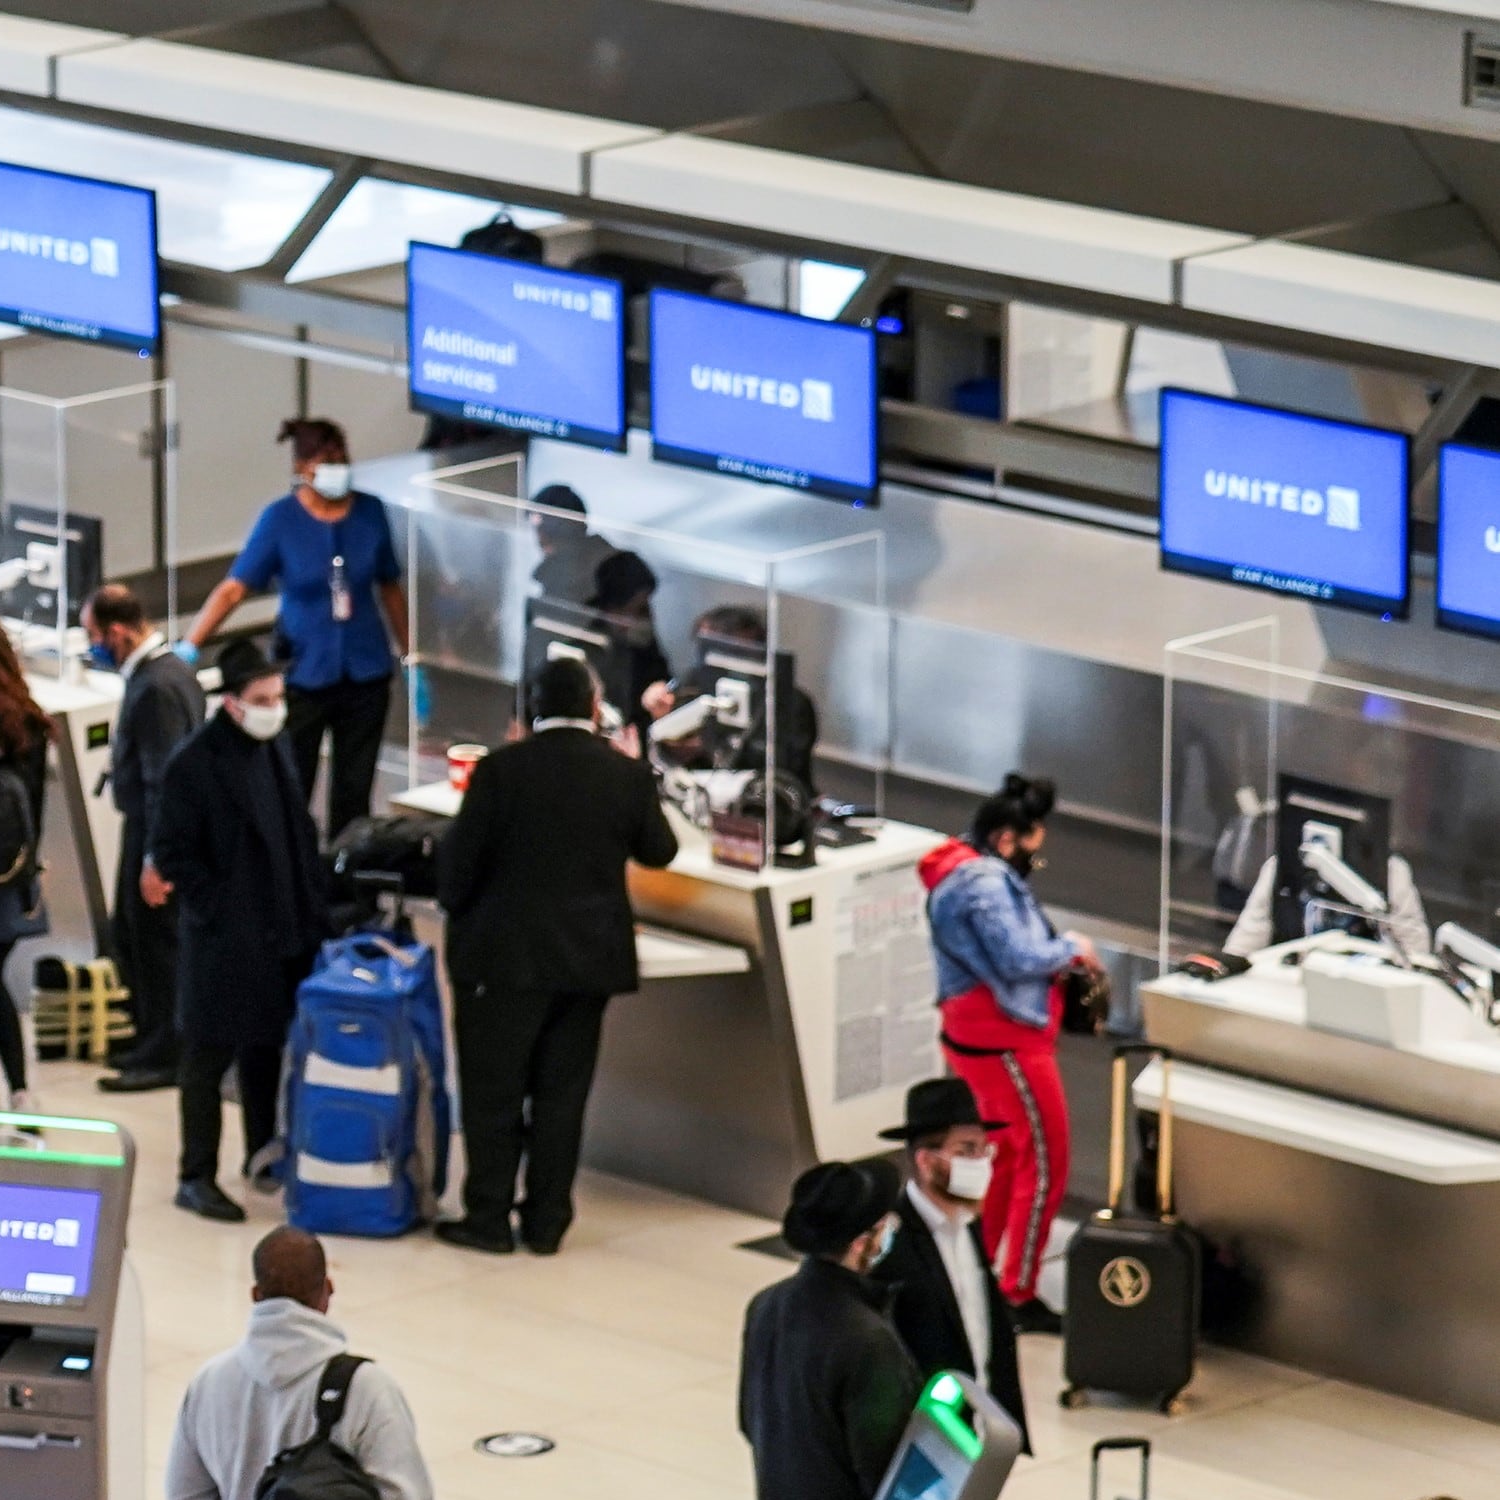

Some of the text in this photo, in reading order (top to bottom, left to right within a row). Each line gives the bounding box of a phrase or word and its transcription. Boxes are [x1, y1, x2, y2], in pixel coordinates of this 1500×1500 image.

[421, 325, 517, 367] Additional
[422, 360, 497, 394] services
[690, 364, 800, 408] UNITED
[1204, 468, 1325, 516] UNITED
